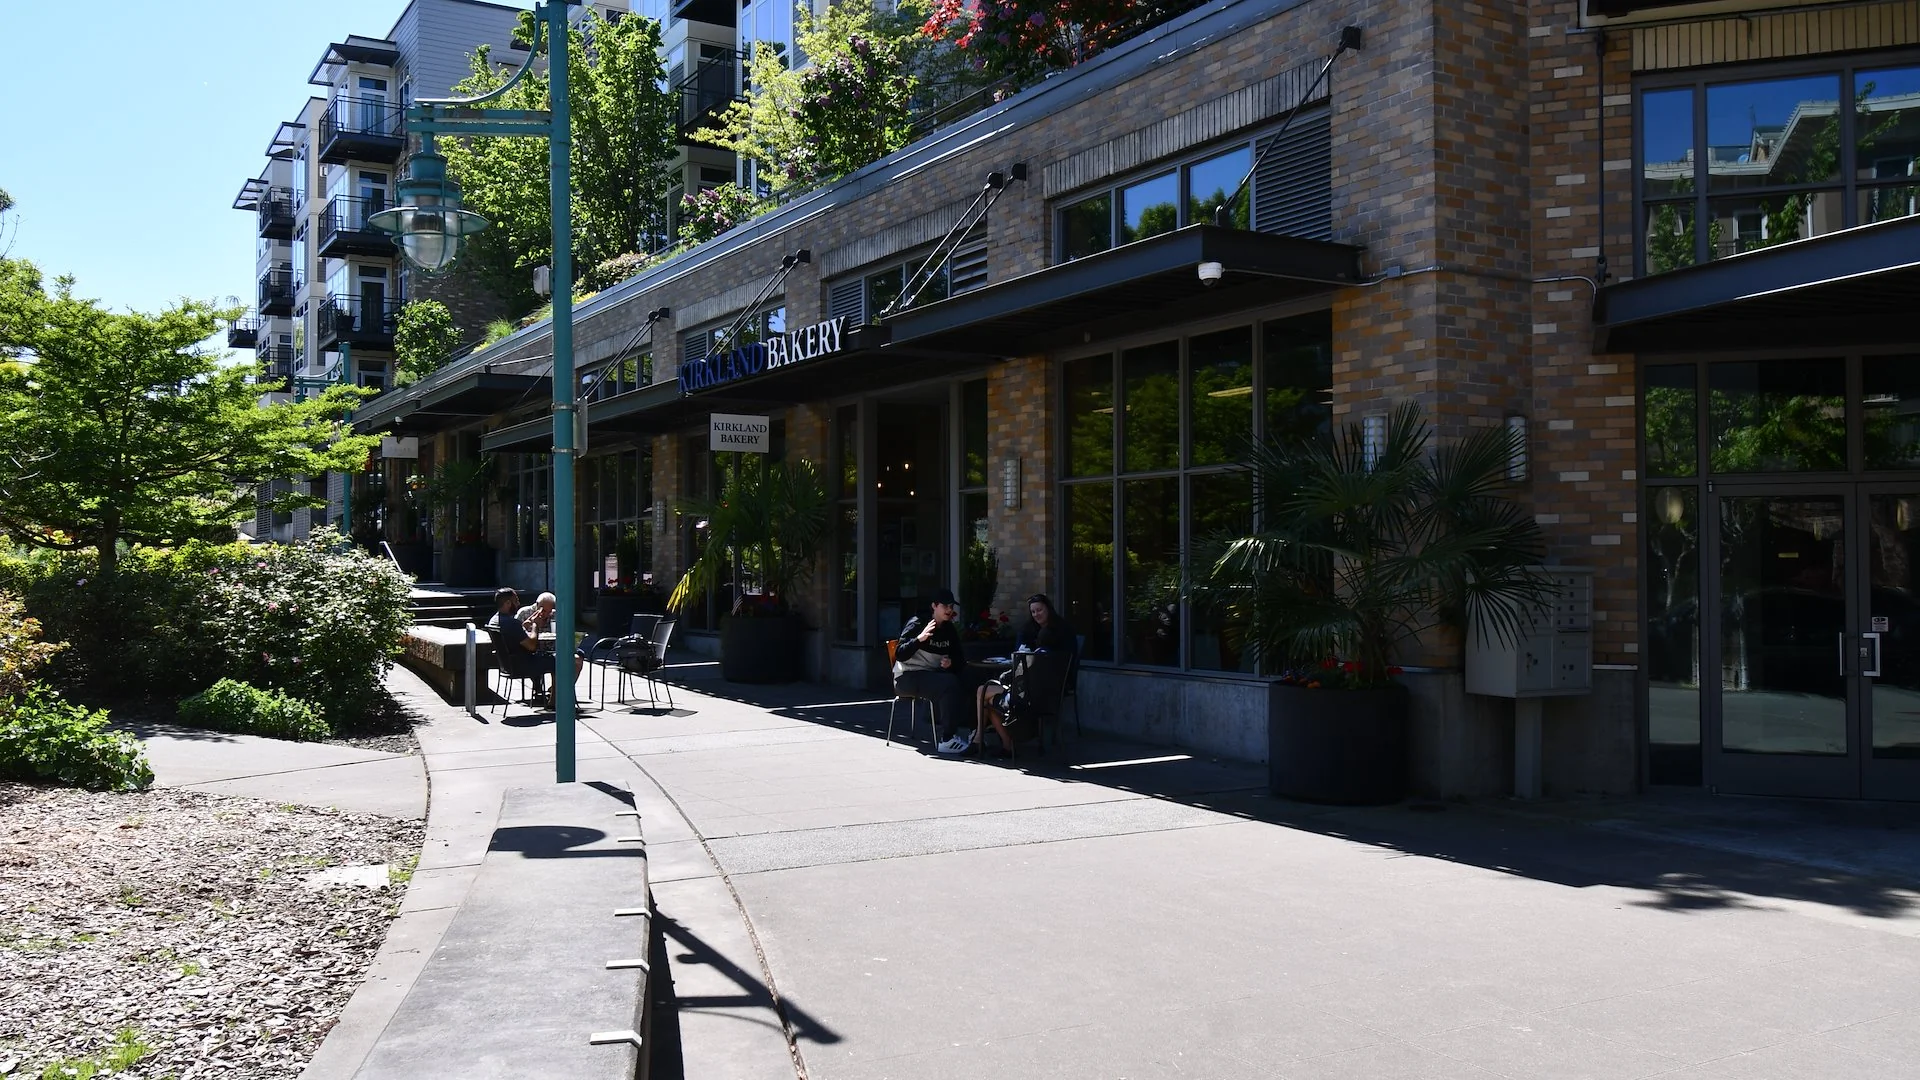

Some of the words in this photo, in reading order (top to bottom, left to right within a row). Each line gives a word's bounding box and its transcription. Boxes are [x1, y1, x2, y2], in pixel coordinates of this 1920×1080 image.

[678, 342, 764, 392] KIRKLAND
[767, 315, 846, 370] BAKERY
[713, 422, 767, 433] KIRKLAND
[720, 434, 760, 444] BAKERY
